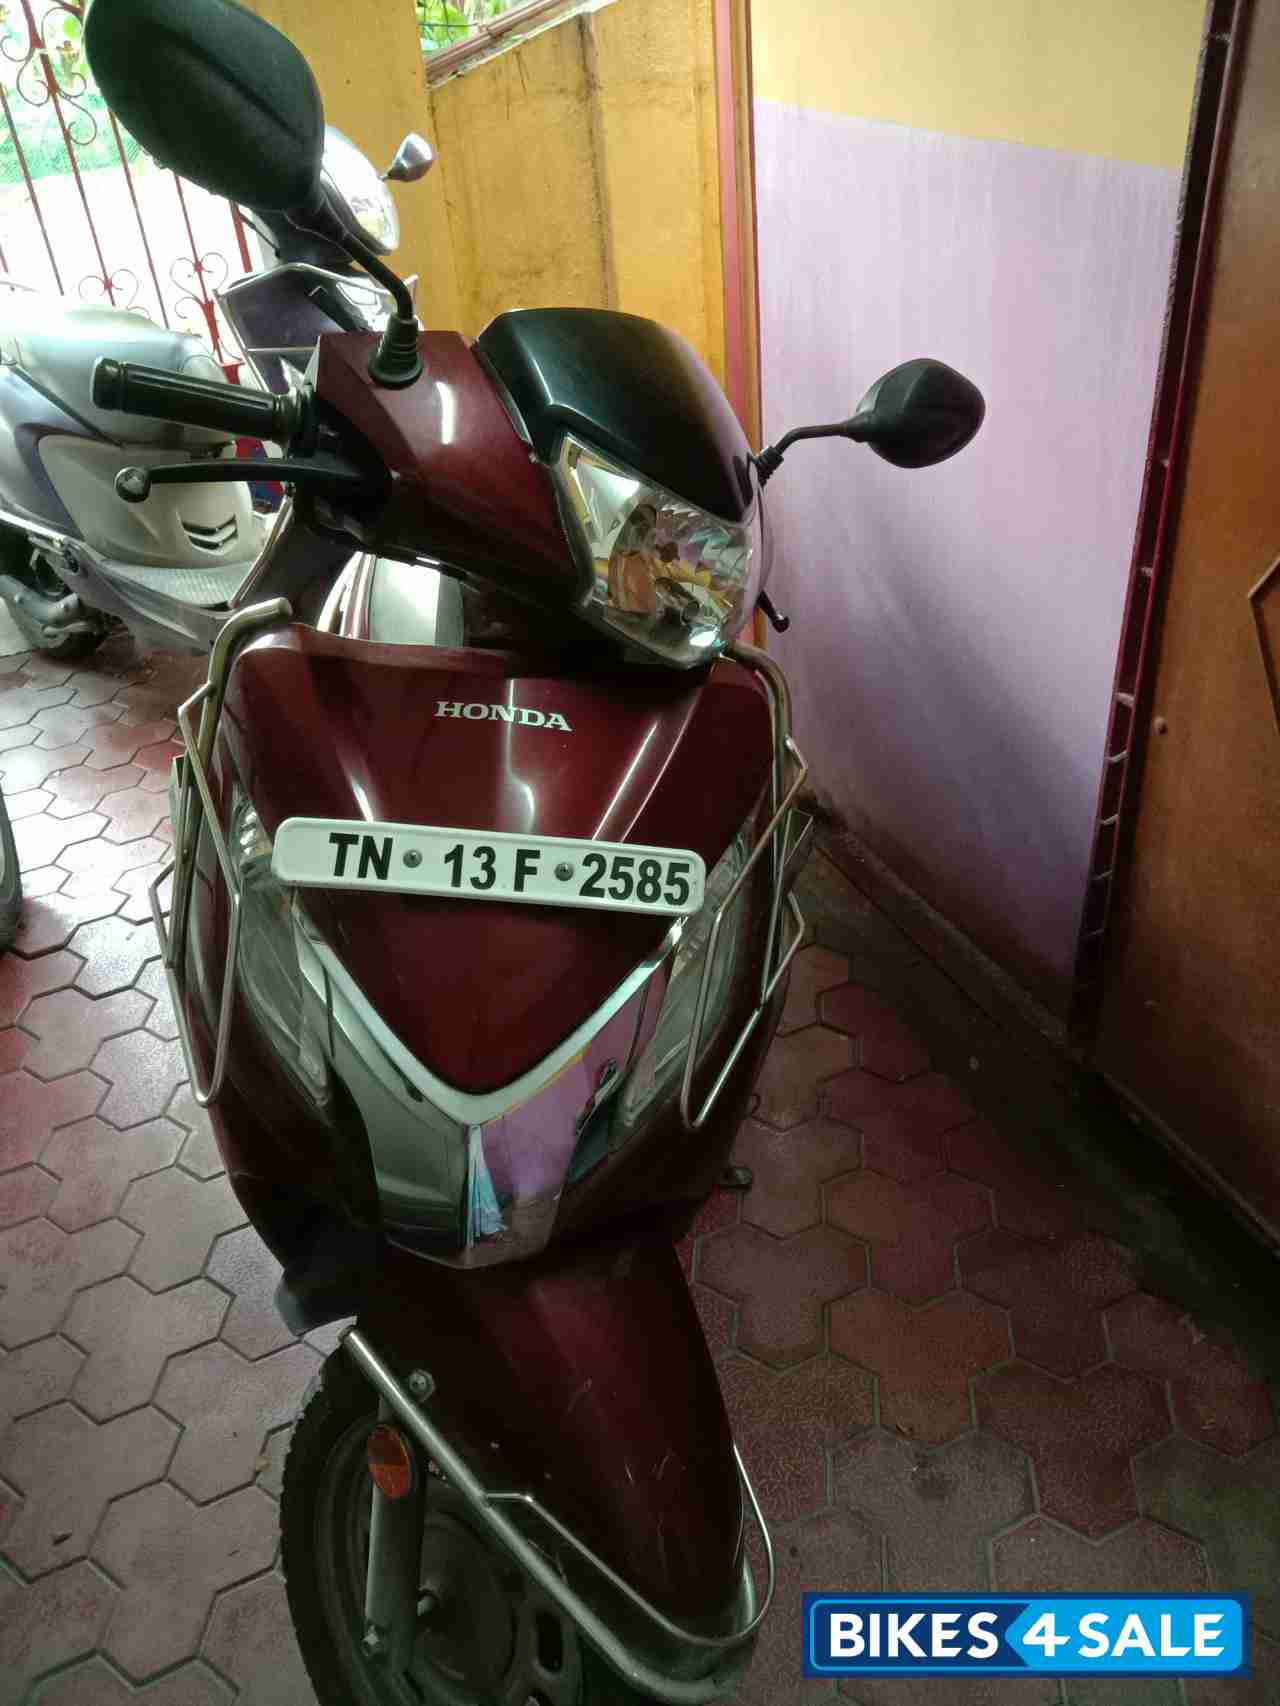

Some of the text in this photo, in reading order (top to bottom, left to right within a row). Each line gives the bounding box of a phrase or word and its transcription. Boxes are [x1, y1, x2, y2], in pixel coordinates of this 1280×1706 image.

[435, 701, 573, 731] HONDA
[329, 832, 691, 906] TN 13 F 2585
